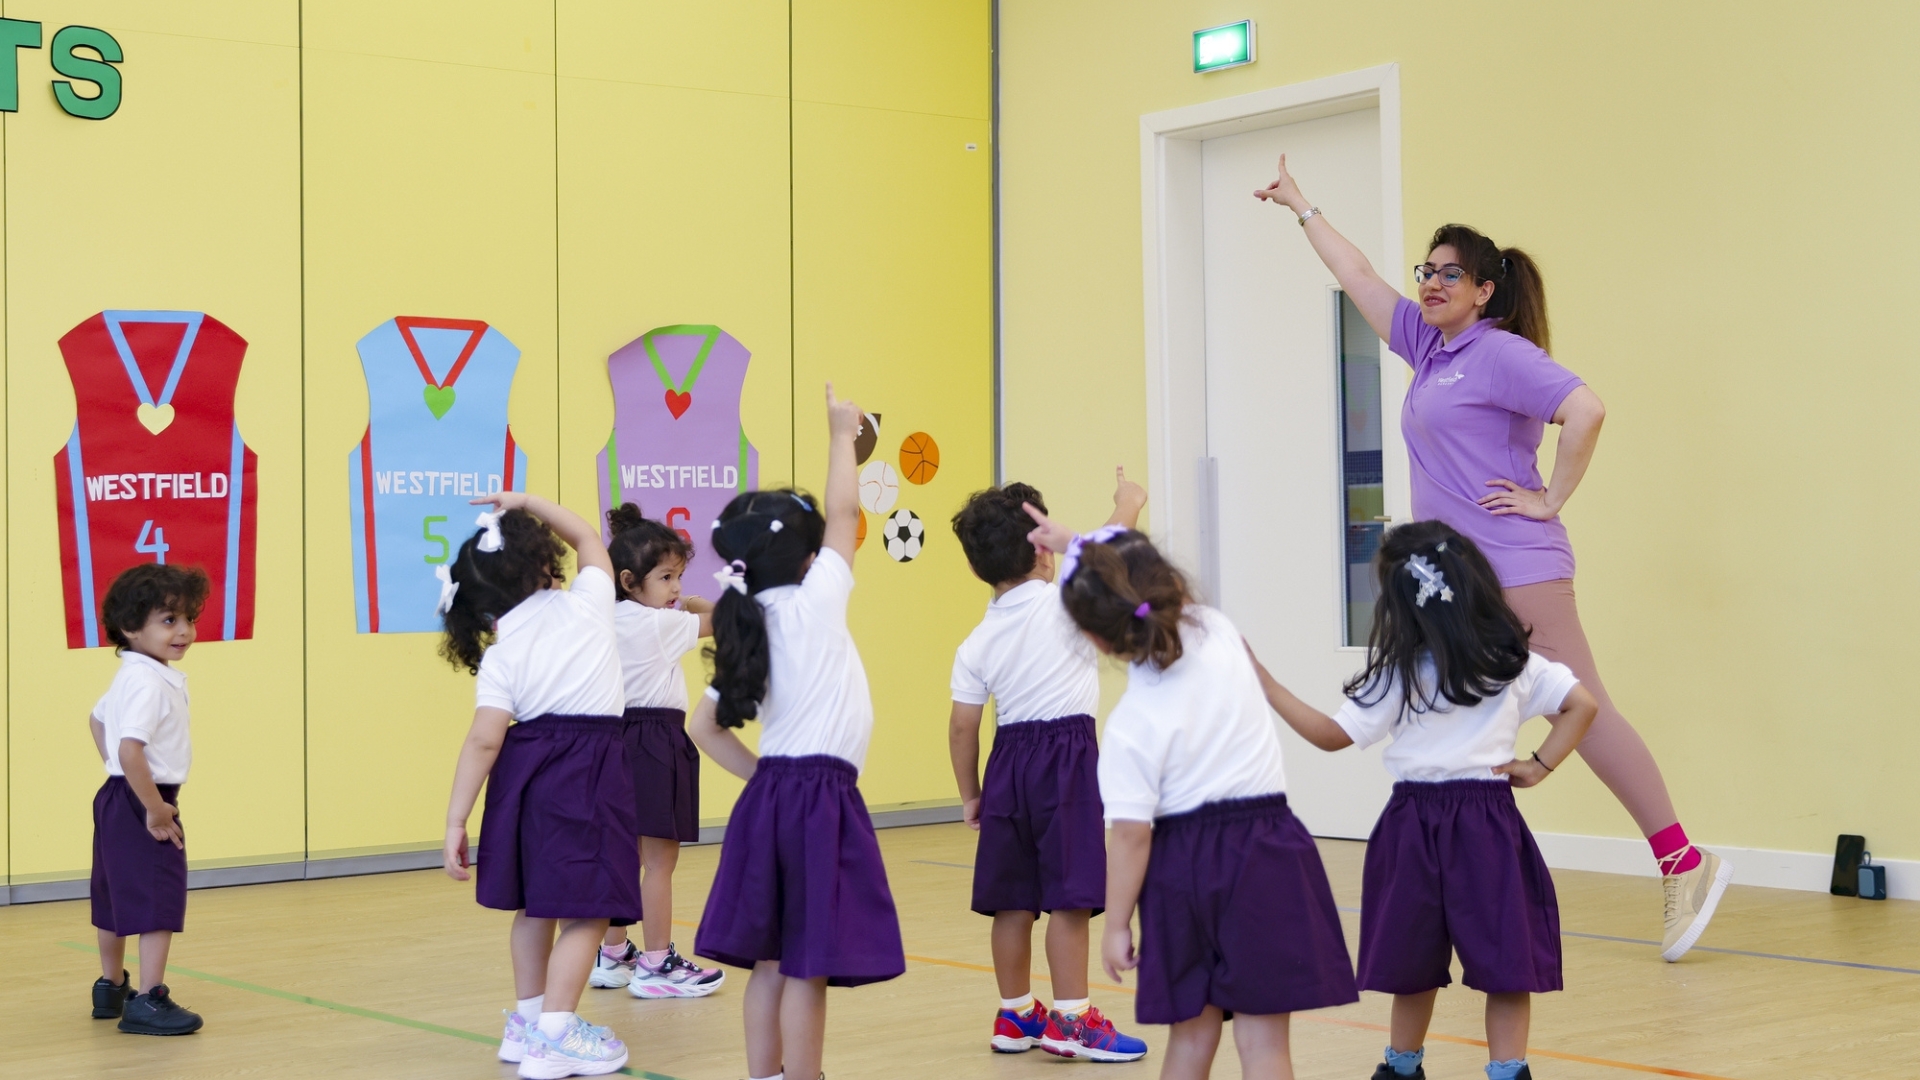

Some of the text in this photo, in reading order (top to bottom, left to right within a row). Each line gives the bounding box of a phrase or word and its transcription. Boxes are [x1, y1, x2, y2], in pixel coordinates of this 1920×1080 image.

[86, 472, 228, 501] WESTFIELD
[376, 471, 502, 497] WESTFIELD
[621, 464, 738, 489] WESTFIELD
[134, 519, 169, 565] 4
[423, 515, 449, 564] 5
